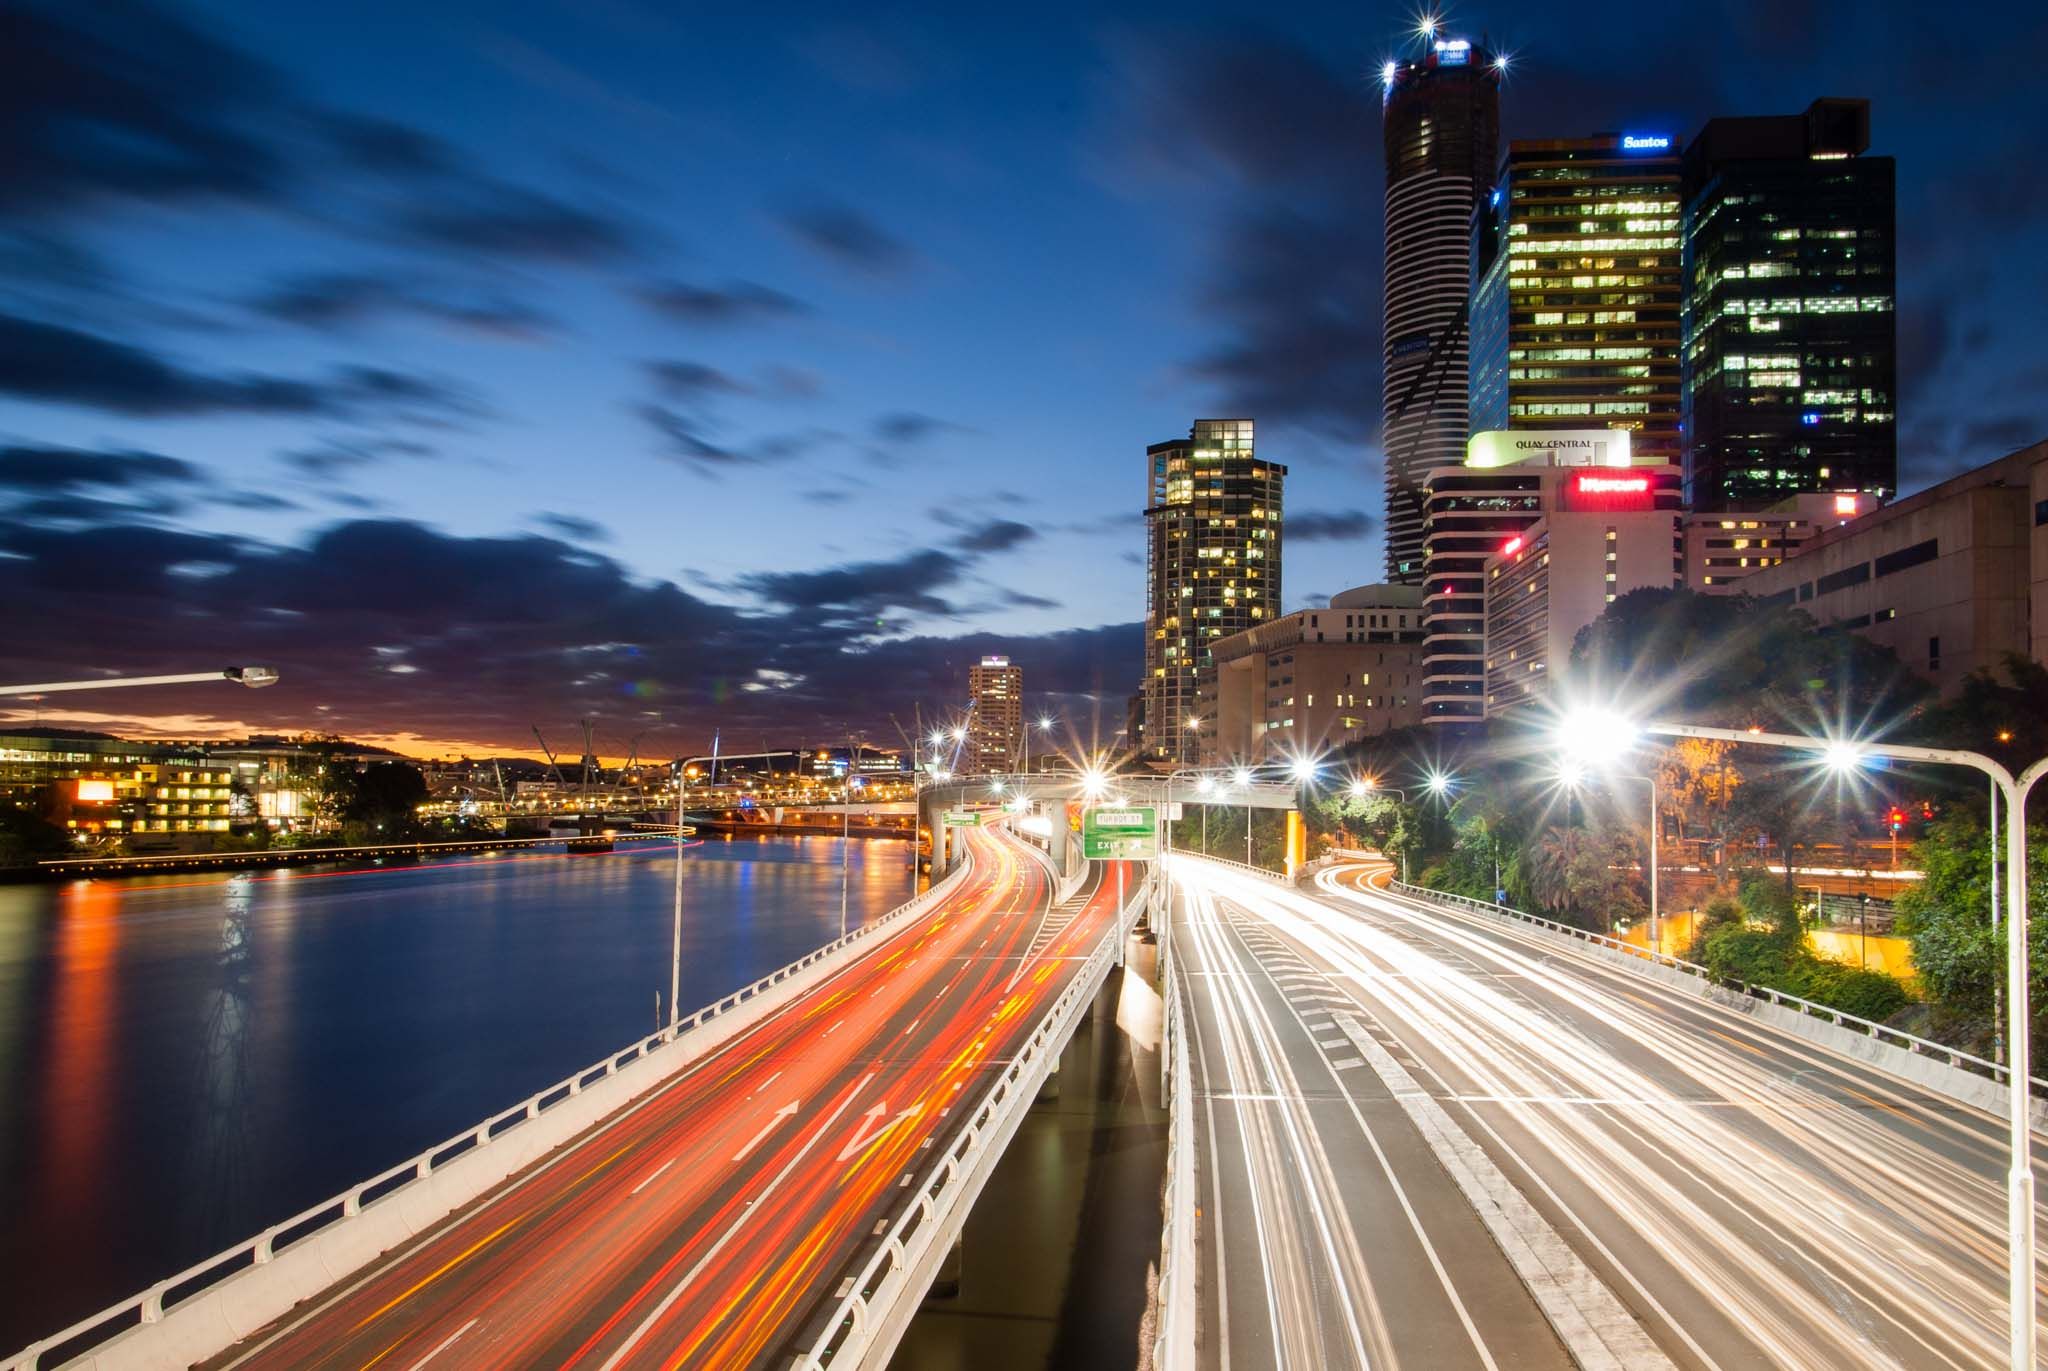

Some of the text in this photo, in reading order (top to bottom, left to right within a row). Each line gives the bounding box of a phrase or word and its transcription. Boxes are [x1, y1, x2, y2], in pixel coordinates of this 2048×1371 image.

[1623, 136, 1668, 148] Santos
[1515, 440, 1591, 449] QUAY CENTRAL
[1097, 841, 1119, 849] EXIT
